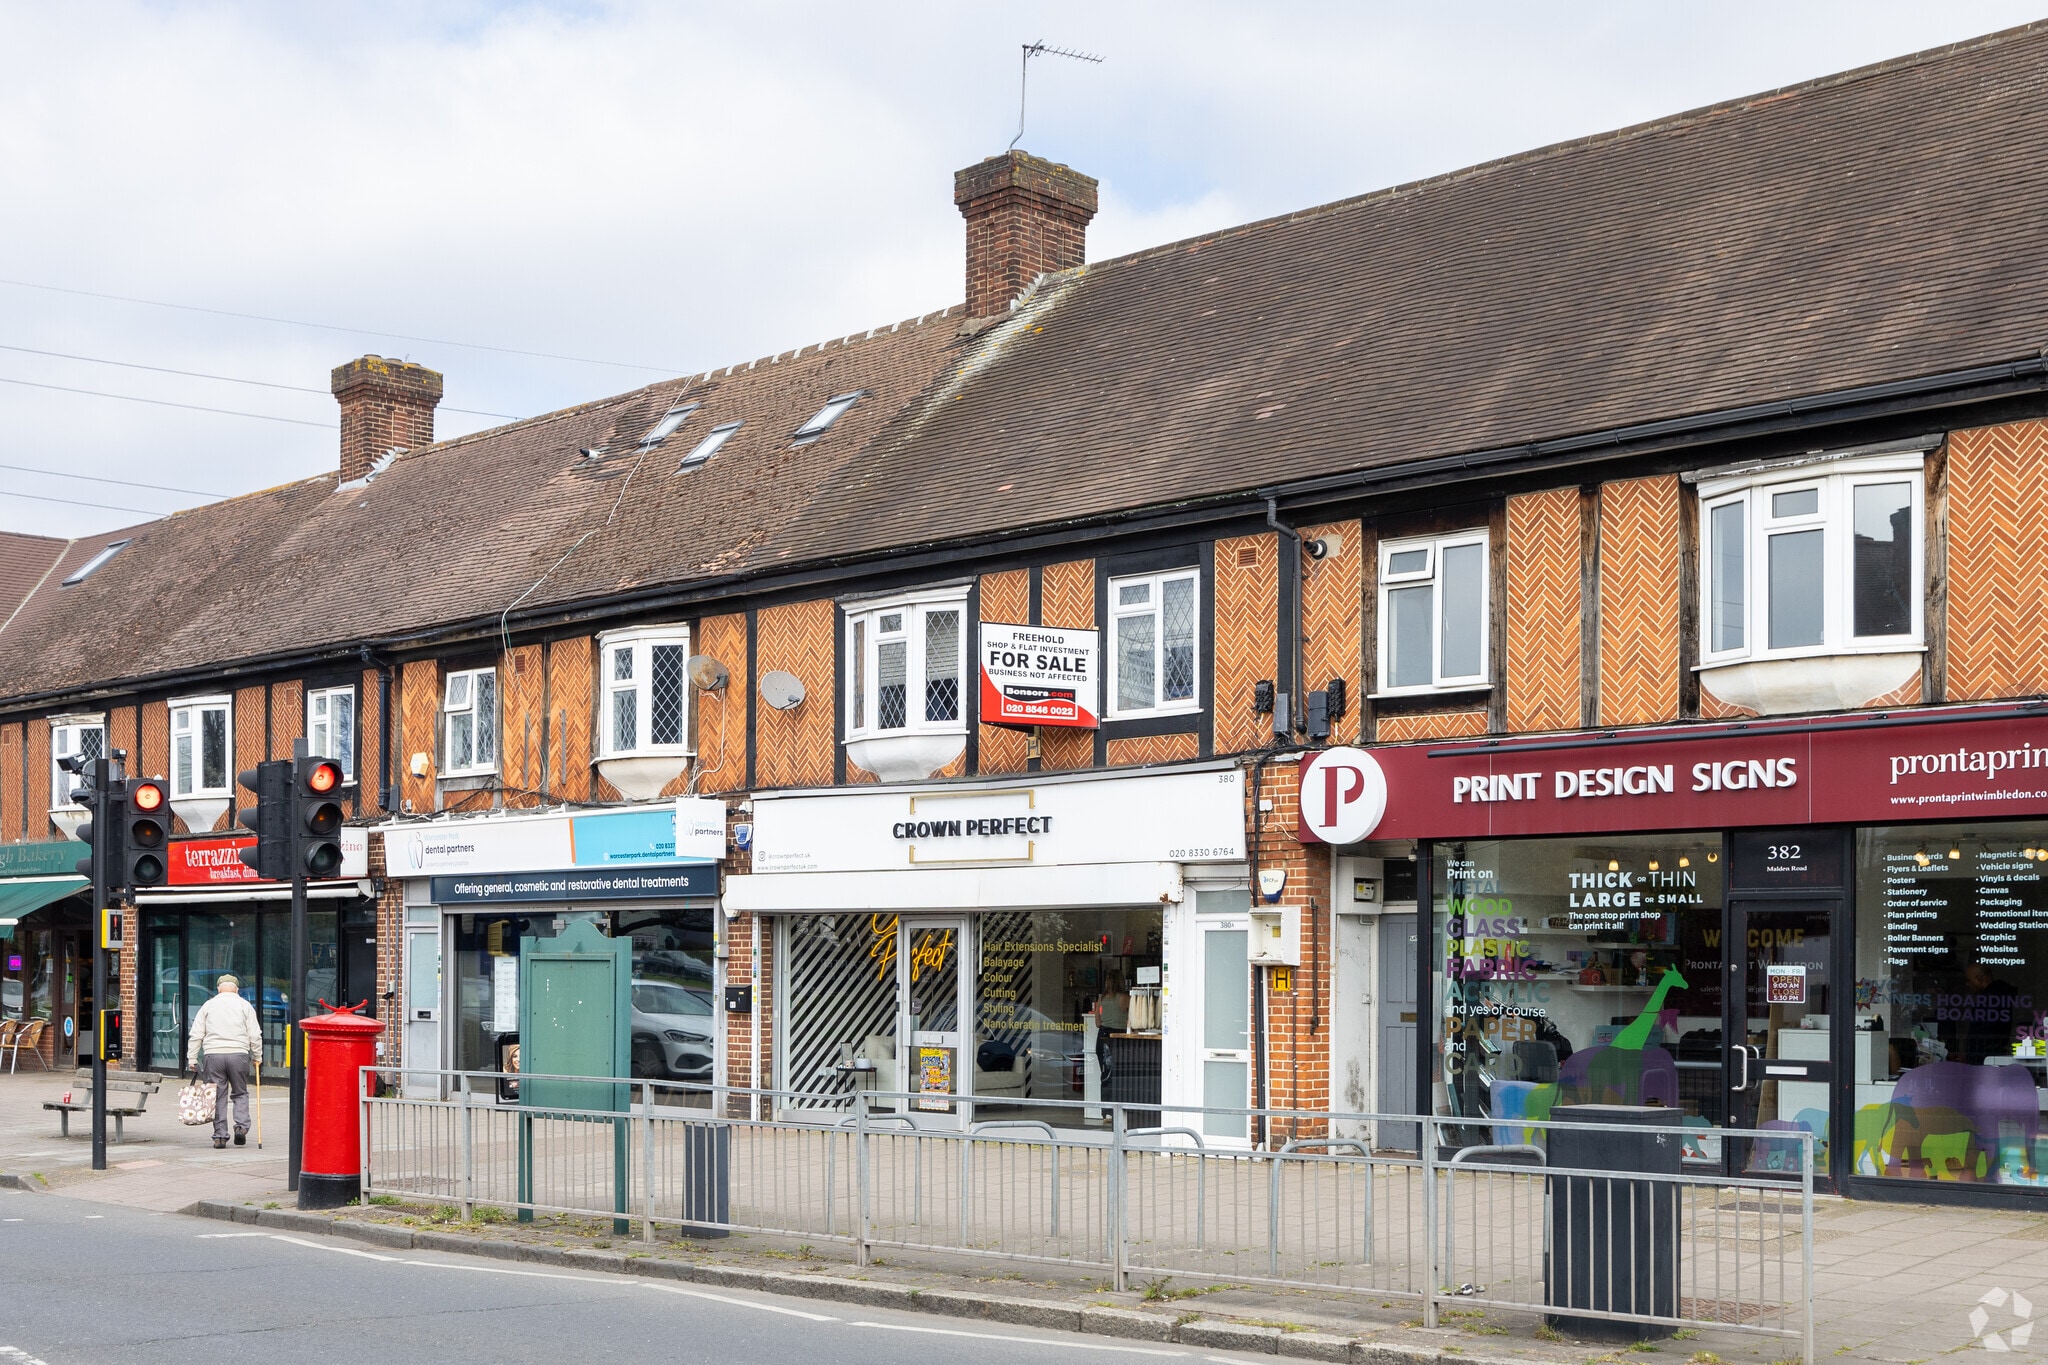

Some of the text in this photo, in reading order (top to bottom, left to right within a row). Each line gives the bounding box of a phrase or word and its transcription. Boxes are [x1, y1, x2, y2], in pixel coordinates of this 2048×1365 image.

[1012, 632, 1064, 644] FREEHOLD
[1040, 646, 1090, 655] INVESTMENT
[990, 651, 1086, 673] FOR SALE
[988, 668, 1087, 682] BUSINESS NOT AFFECTED
[1006, 687, 1073, 698] Bonsors.com
[1006, 704, 1073, 716] 020 8546 0022
[1218, 774, 1234, 783] 380
[1453, 758, 1797, 803] PRINT DESIGN SIGNS
[1319, 766, 1364, 828] P
[694, 828, 723, 836] partners
[892, 816, 1052, 839] CROWN PERFECT
[18, 846, 65, 864] Bakery
[425, 844, 474, 856] dental partners
[1169, 847, 1234, 858] 020 8330 6764
[1768, 845, 1801, 859] 382
[1980, 851, 2017, 860] Magnetic
[2012, 862, 2033, 870] signs
[1447, 868, 1493, 879] Print on
[1568, 872, 1632, 888] THICK
[1648, 871, 1696, 887] THIN
[1980, 875, 2005, 883] Vinyls
[454, 876, 689, 896] Offering general, cosmetic and restorative dental treatments
[1447, 880, 1504, 895] METAL
[1887, 888, 1927, 896] Stationery
[1447, 898, 1513, 915] WOOD
[1569, 892, 1641, 908] LARGE
[1658, 894, 1703, 904] SMALL
[1980, 898, 2022, 907] Packaging
[1600, 912, 1618, 920] stop
[1620, 911, 1639, 920] print
[1641, 911, 1661, 920] shop
[1906, 911, 1937, 919] printing
[1980, 910, 2030, 918] Promotional
[1446, 918, 1520, 938] GLASS
[1584, 922, 1603, 931] print
[1888, 922, 1918, 931] Binding
[1980, 922, 2017, 930] Wedding
[1702, 928, 1804, 948] WCOME
[1980, 933, 2016, 942] Graphics
[984, 941, 1103, 954] Hair Extensions Specialist
[1447, 940, 1530, 957] PLASTIC
[1928, 946, 1949, 954] signs
[984, 957, 1024, 970] Balayage
[1888, 957, 1908, 966] Flags
[1980, 957, 2025, 966] Prototypes
[1447, 958, 1537, 980] FABRIC
[984, 972, 1013, 982] Colour
[984, 987, 1016, 1000] Cutting
[1445, 981, 1551, 1003] ACRYLIC
[1936, 994, 2032, 1008] HOARDING
[984, 1003, 1014, 1016] Styling
[1445, 1004, 1546, 1017] and yes of course
[1936, 1008, 2010, 1022] BOARDS
[983, 1019, 1088, 1032] Nano keratin treatment
[1445, 1017, 1537, 1042] PAPER
[1444, 1041, 1466, 1051] and
[1445, 1052, 1523, 1077] CARD
